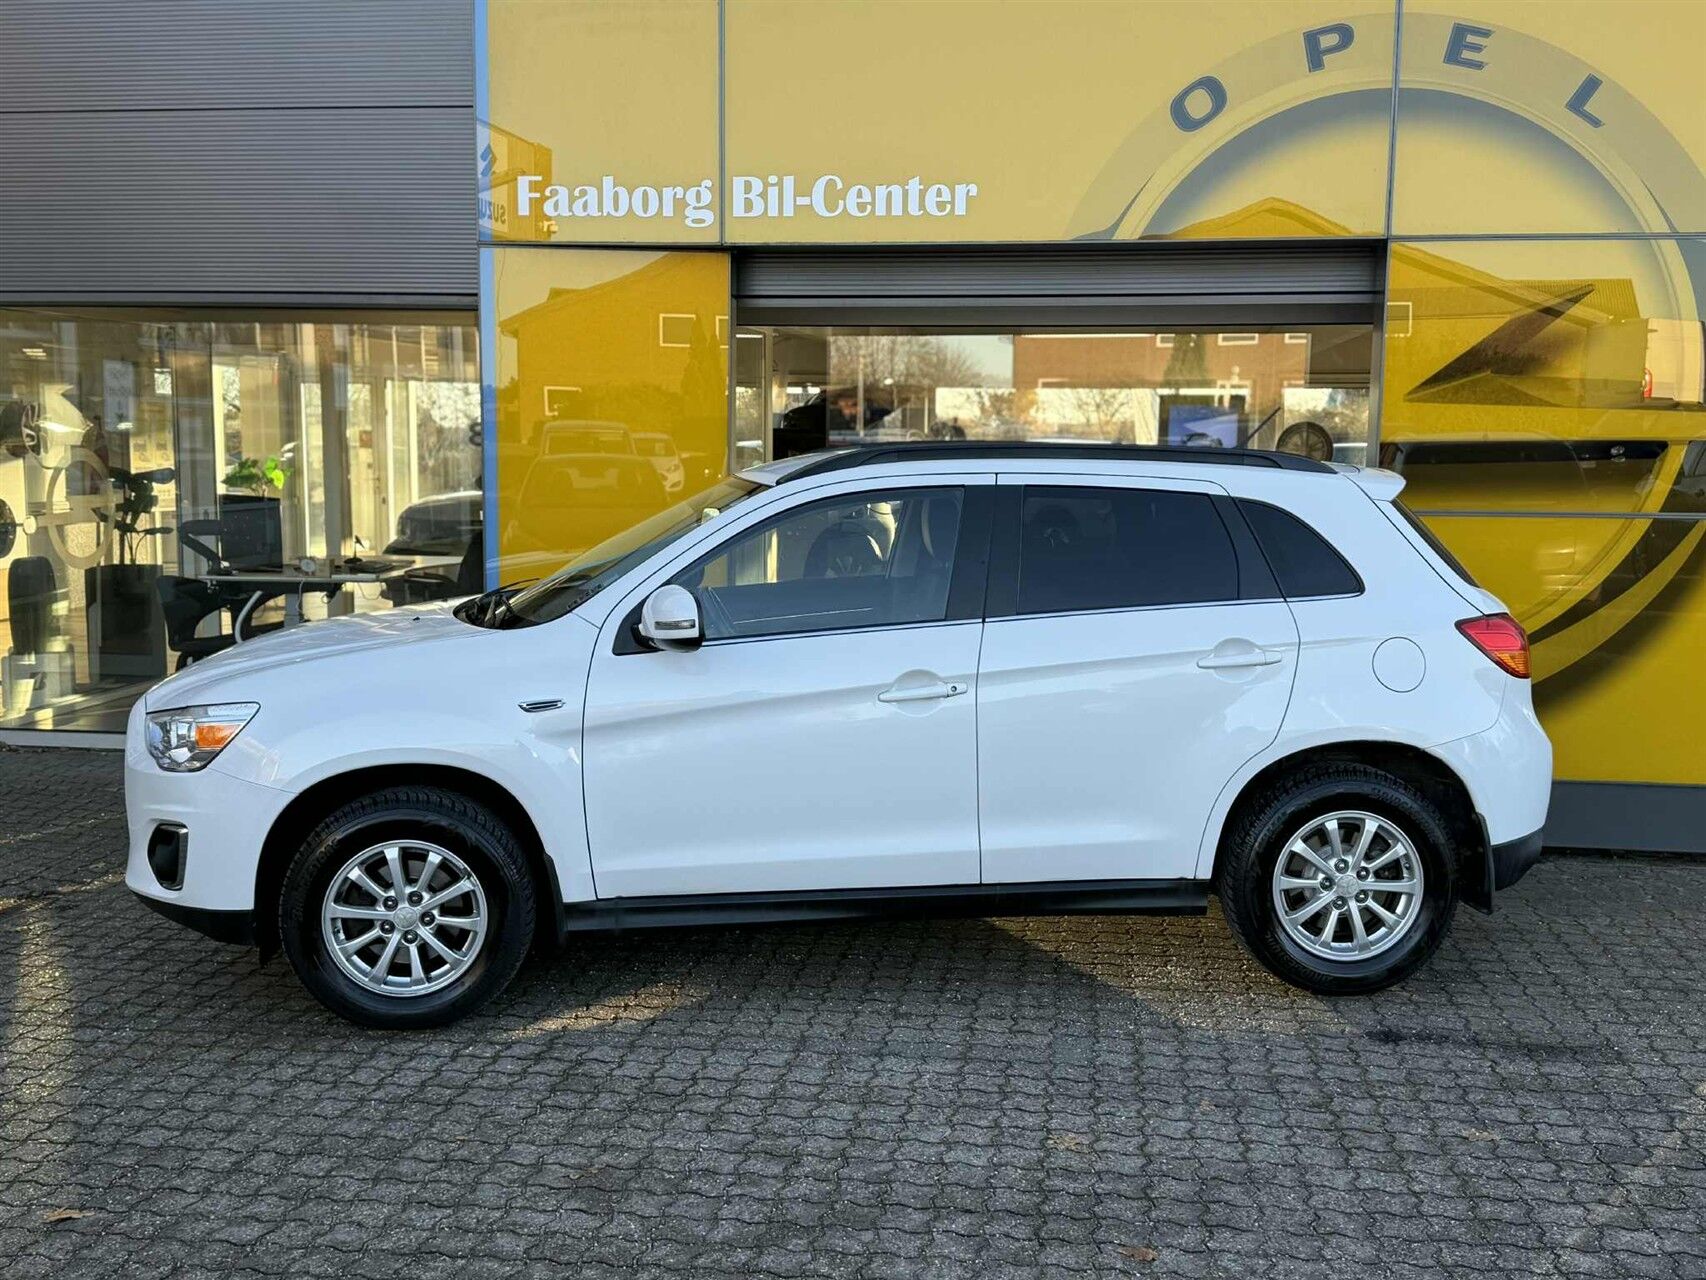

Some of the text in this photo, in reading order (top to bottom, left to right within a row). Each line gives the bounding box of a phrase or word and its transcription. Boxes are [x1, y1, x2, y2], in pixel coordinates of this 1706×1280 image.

[1169, 22, 1606, 133] OPEL
[518, 175, 977, 227] Faaborg Bil-Center
